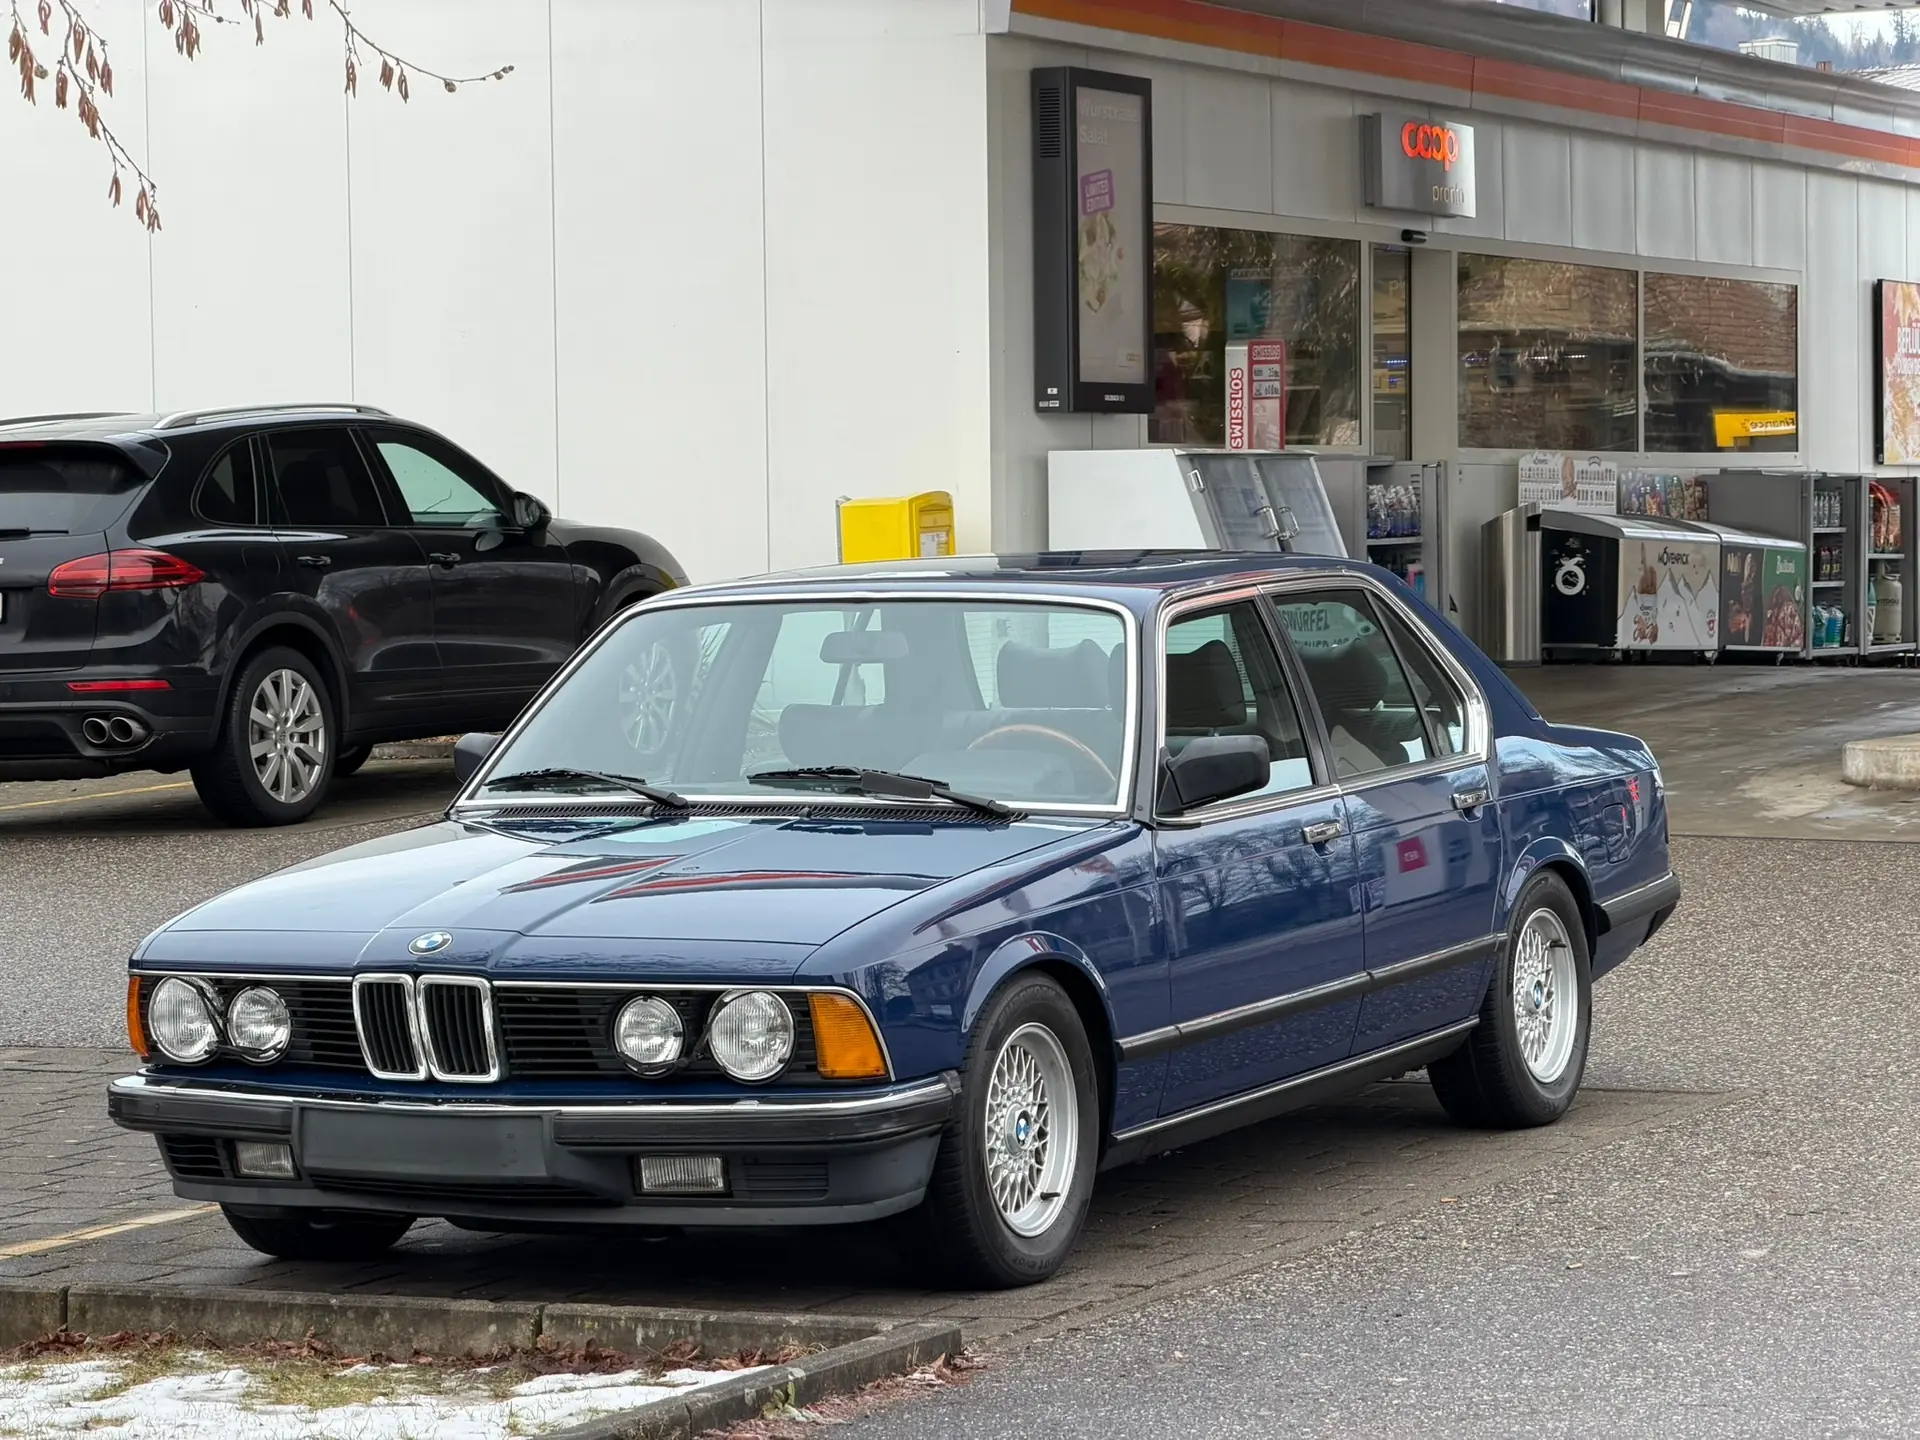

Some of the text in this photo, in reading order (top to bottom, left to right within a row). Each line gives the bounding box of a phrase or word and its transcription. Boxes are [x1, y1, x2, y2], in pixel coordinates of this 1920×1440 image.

[1401, 121, 1459, 171] coop
[1432, 183, 1465, 205] pronto
[1229, 367, 1244, 450] SWISSLOS
